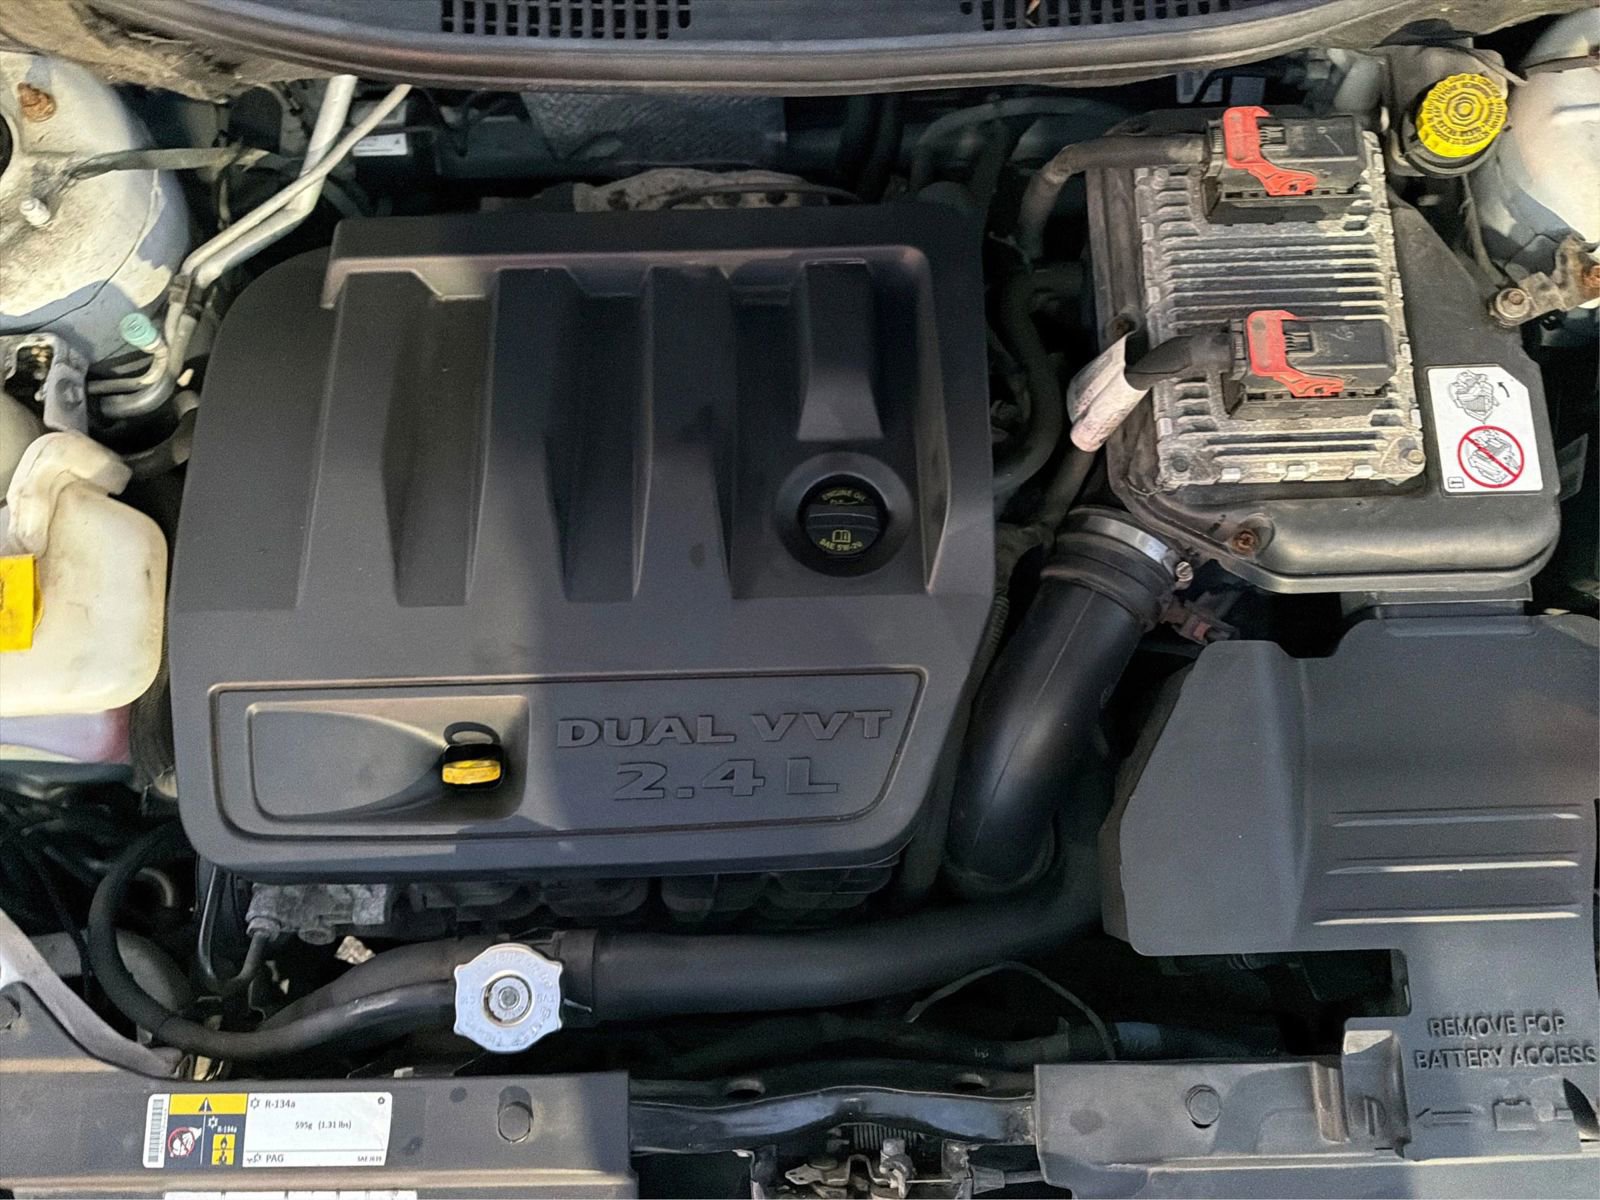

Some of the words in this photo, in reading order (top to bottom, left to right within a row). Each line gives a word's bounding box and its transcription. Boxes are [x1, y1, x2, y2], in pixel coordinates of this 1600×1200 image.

[555, 713, 738, 749] DUAL
[750, 709, 893, 743] VVT
[613, 758, 766, 802] 2.4
[784, 756, 840, 796] L
[1428, 1013, 1519, 1038] REMOVE
[1415, 1048, 1505, 1070] BATTERY
[1512, 1043, 1599, 1067] ACCESS
[264, 1098, 296, 1109] R-134a
[295, 1121, 313, 1131] 595g
[265, 1154, 285, 1163] PAG
